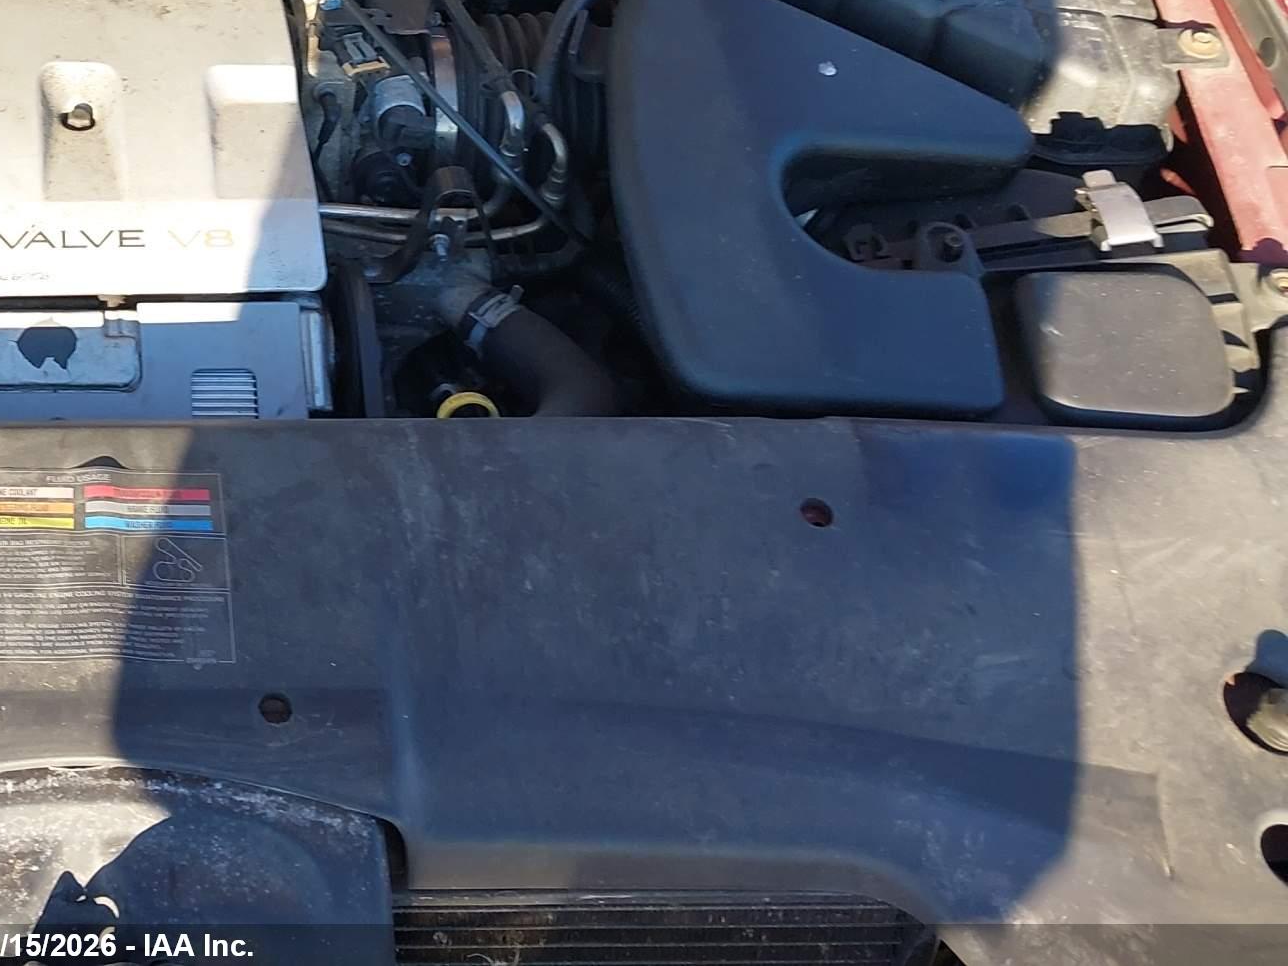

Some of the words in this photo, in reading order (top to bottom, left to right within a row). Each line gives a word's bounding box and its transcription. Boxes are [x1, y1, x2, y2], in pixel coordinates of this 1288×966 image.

[167, 230, 235, 248] V8
[46, 475, 74, 483] FLUID
[75, 474, 112, 482] USAGE
